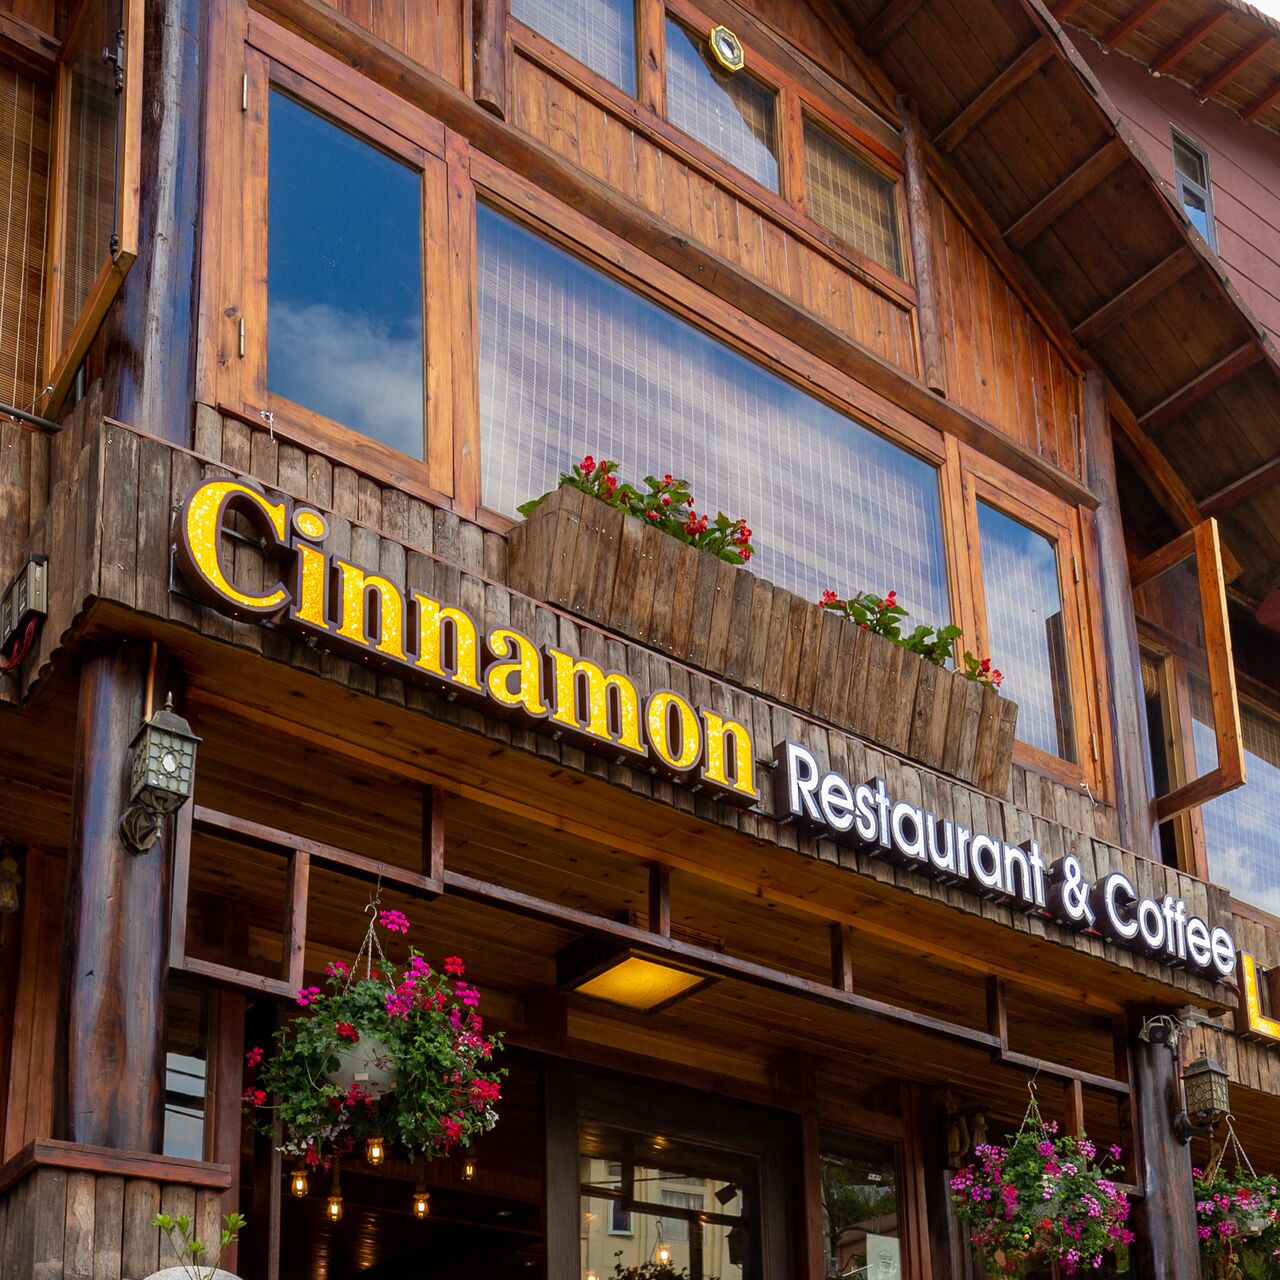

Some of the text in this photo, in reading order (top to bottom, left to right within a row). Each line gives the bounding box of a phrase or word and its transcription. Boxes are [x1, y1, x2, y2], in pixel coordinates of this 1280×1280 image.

[183, 476, 1238, 977] Cinnamon Restaurant & Coffee
